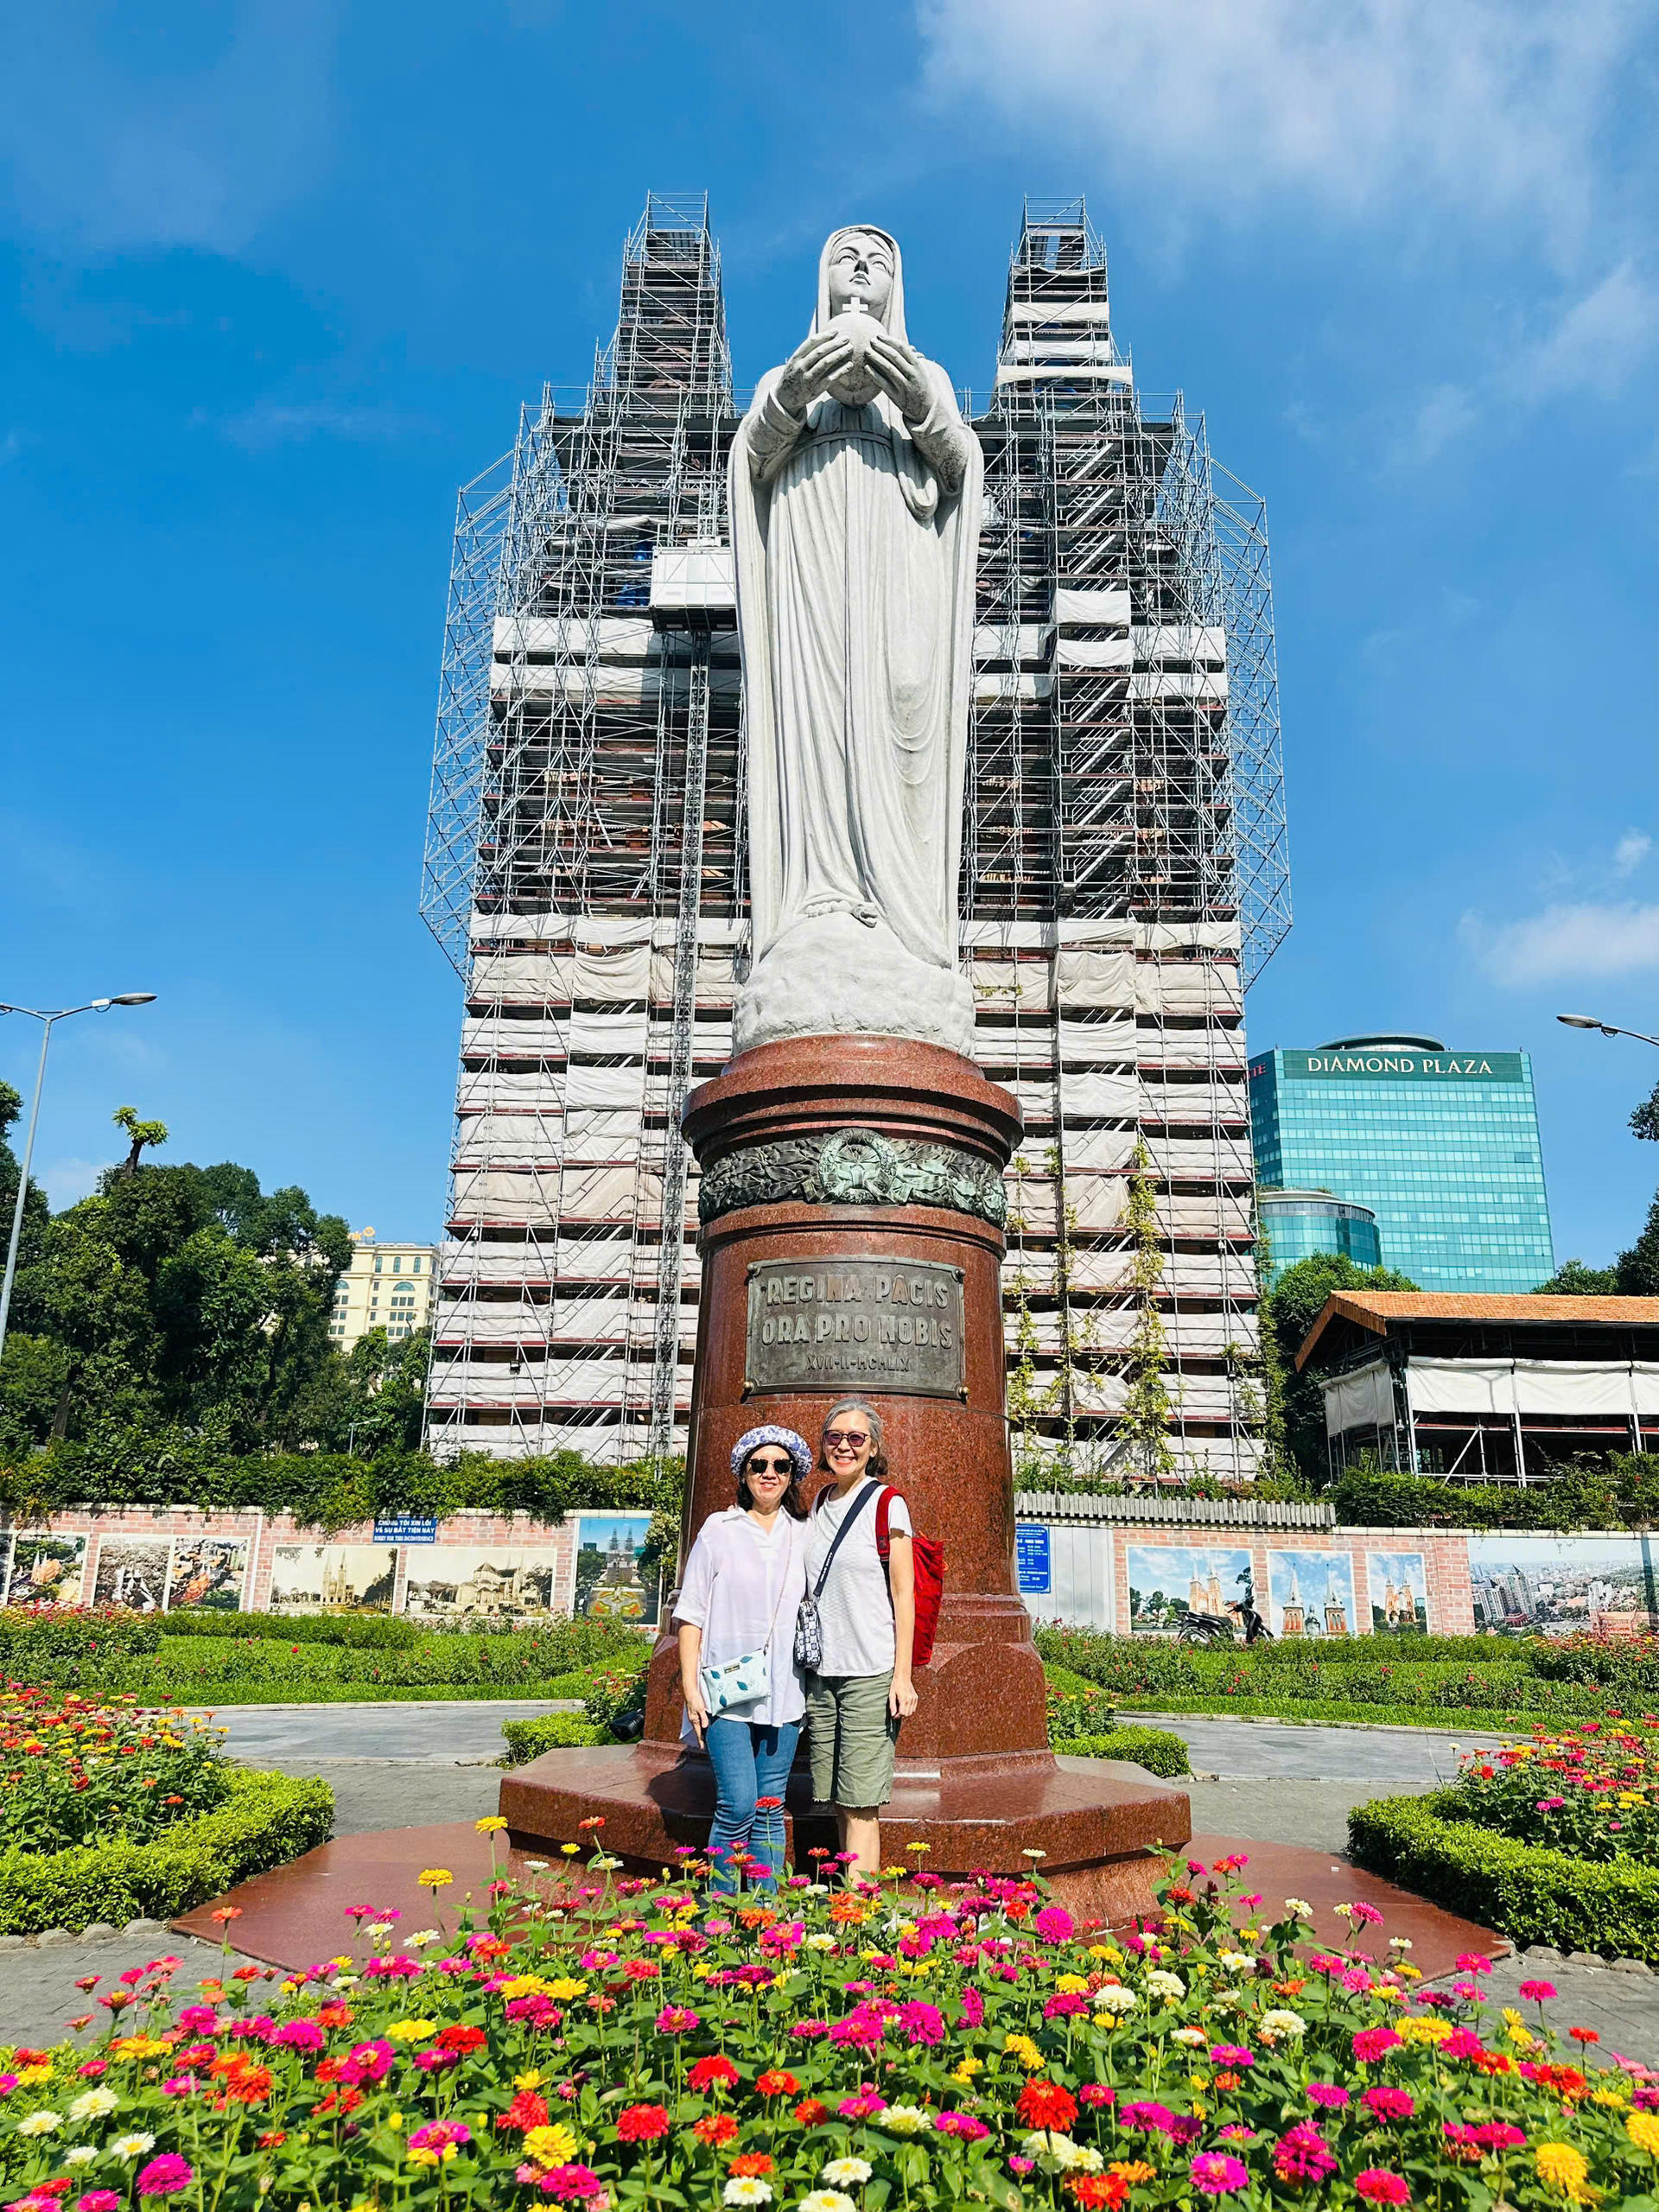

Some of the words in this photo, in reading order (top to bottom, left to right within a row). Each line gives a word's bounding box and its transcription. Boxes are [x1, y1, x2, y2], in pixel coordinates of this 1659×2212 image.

[1307, 1055, 1414, 1073] DIAMOND
[1422, 1058, 1493, 1074] PLAZA
[766, 1274, 862, 1306] REGINA
[875, 1274, 949, 1308] PACIS
[761, 1313, 810, 1345] ORA
[816, 1313, 871, 1343] PRO
[880, 1314, 952, 1349] NOBIS
